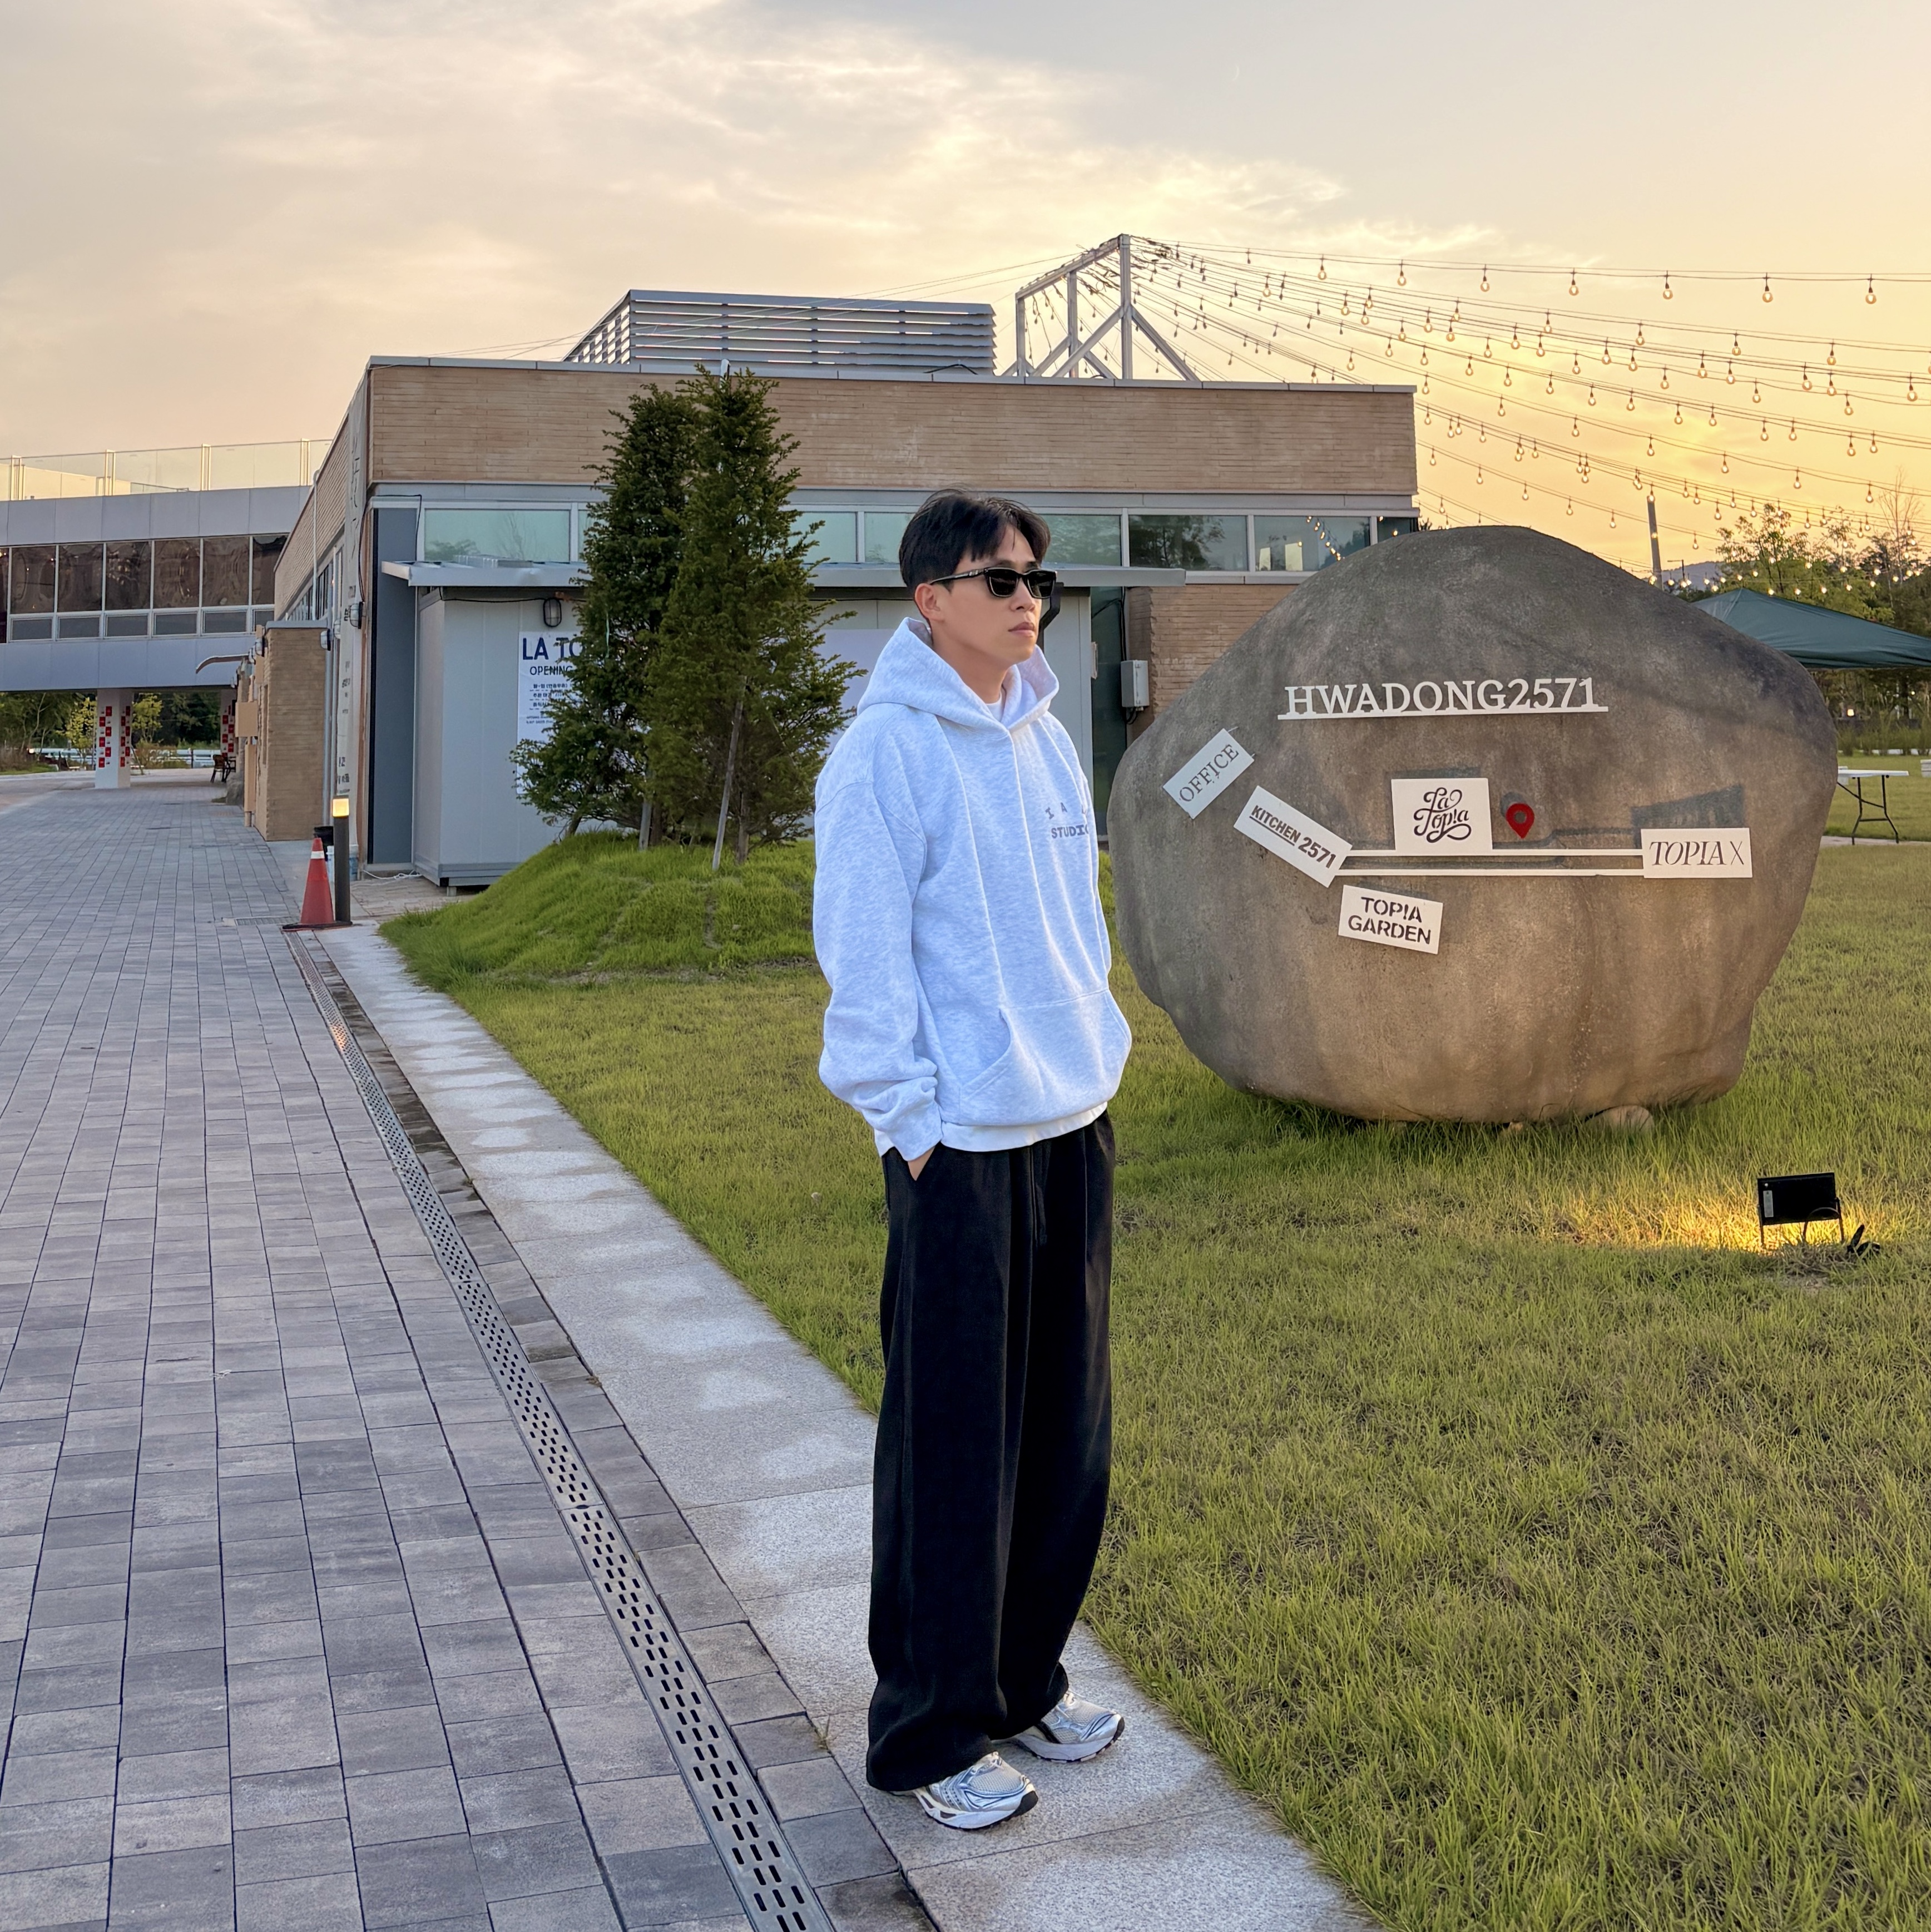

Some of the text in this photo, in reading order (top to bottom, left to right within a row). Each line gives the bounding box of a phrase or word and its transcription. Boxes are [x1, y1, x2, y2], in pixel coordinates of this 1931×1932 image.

[523, 637, 549, 660] LA
[1285, 677, 1599, 715] HWADONG2571
[1179, 744, 1239, 802] OFFICE
[1251, 805, 1336, 869] KITCHEN 2571
[1348, 915, 1431, 945] GARDEN
